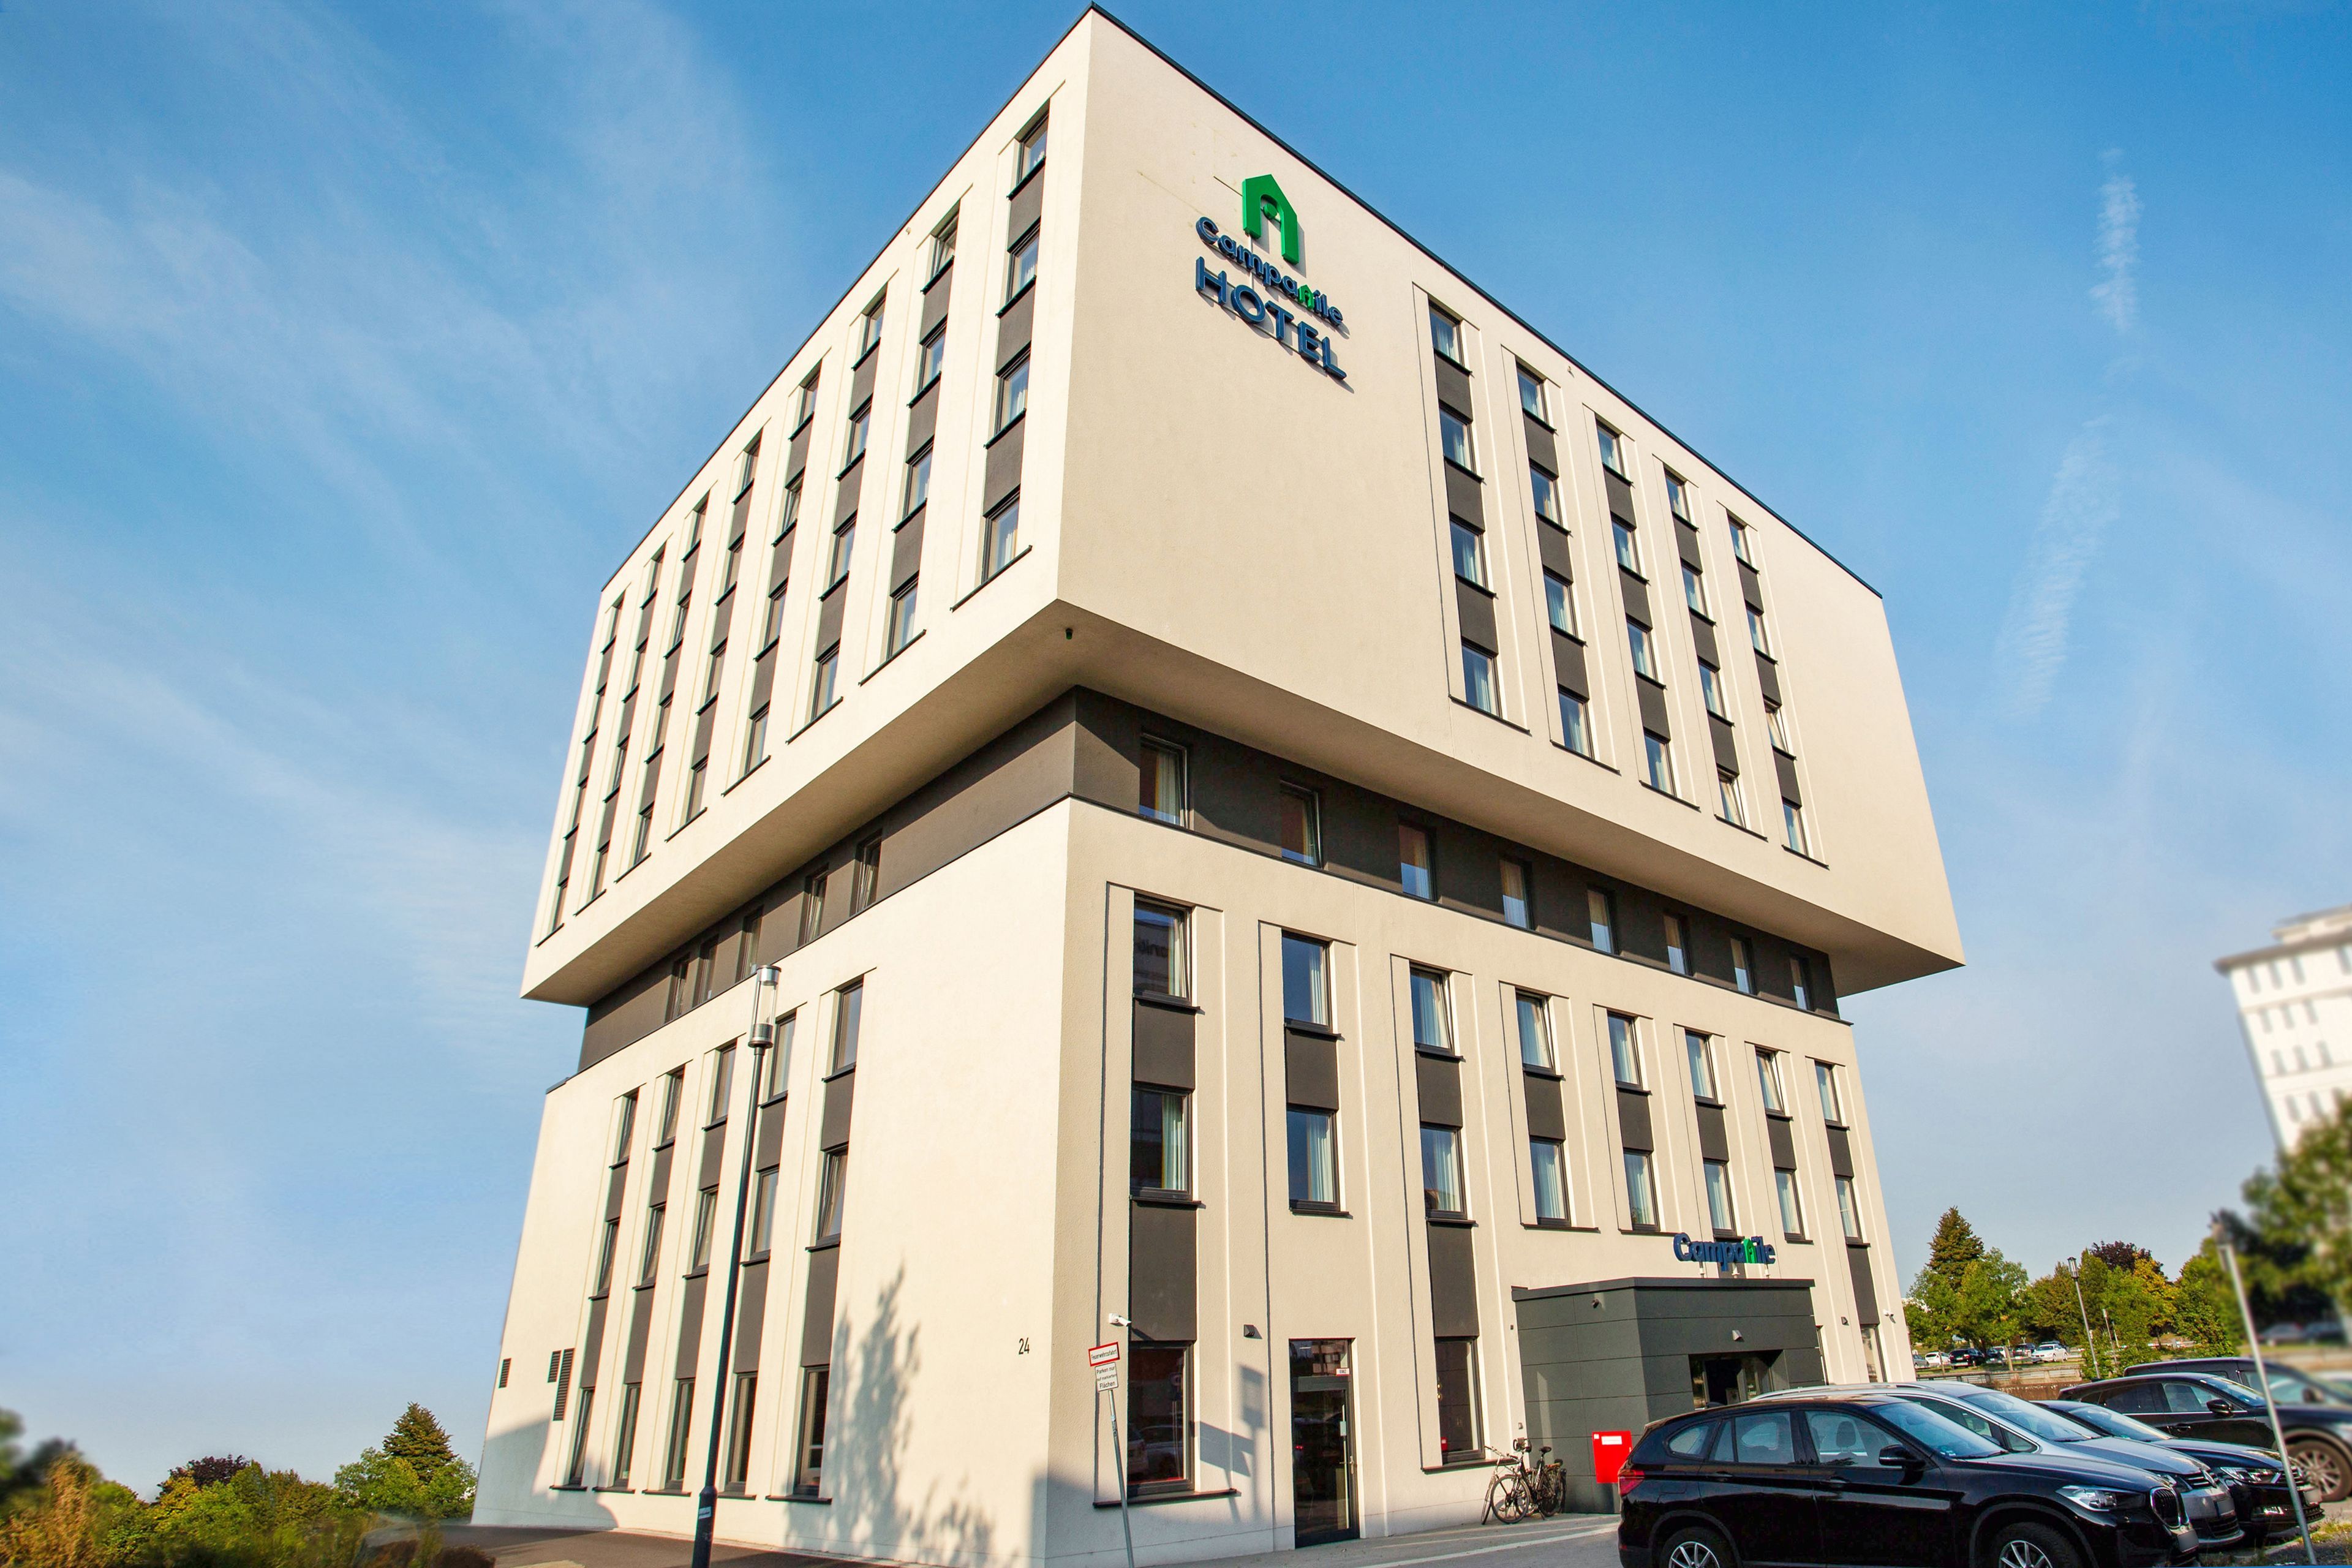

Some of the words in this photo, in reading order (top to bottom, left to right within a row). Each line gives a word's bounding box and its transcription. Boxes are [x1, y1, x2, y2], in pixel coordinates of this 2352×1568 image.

[1196, 216, 1343, 326] Campanile
[1196, 256, 1347, 379] HOTEL
[1673, 1232, 1776, 1272] Campanile
[1019, 1337, 1030, 1355] 24
